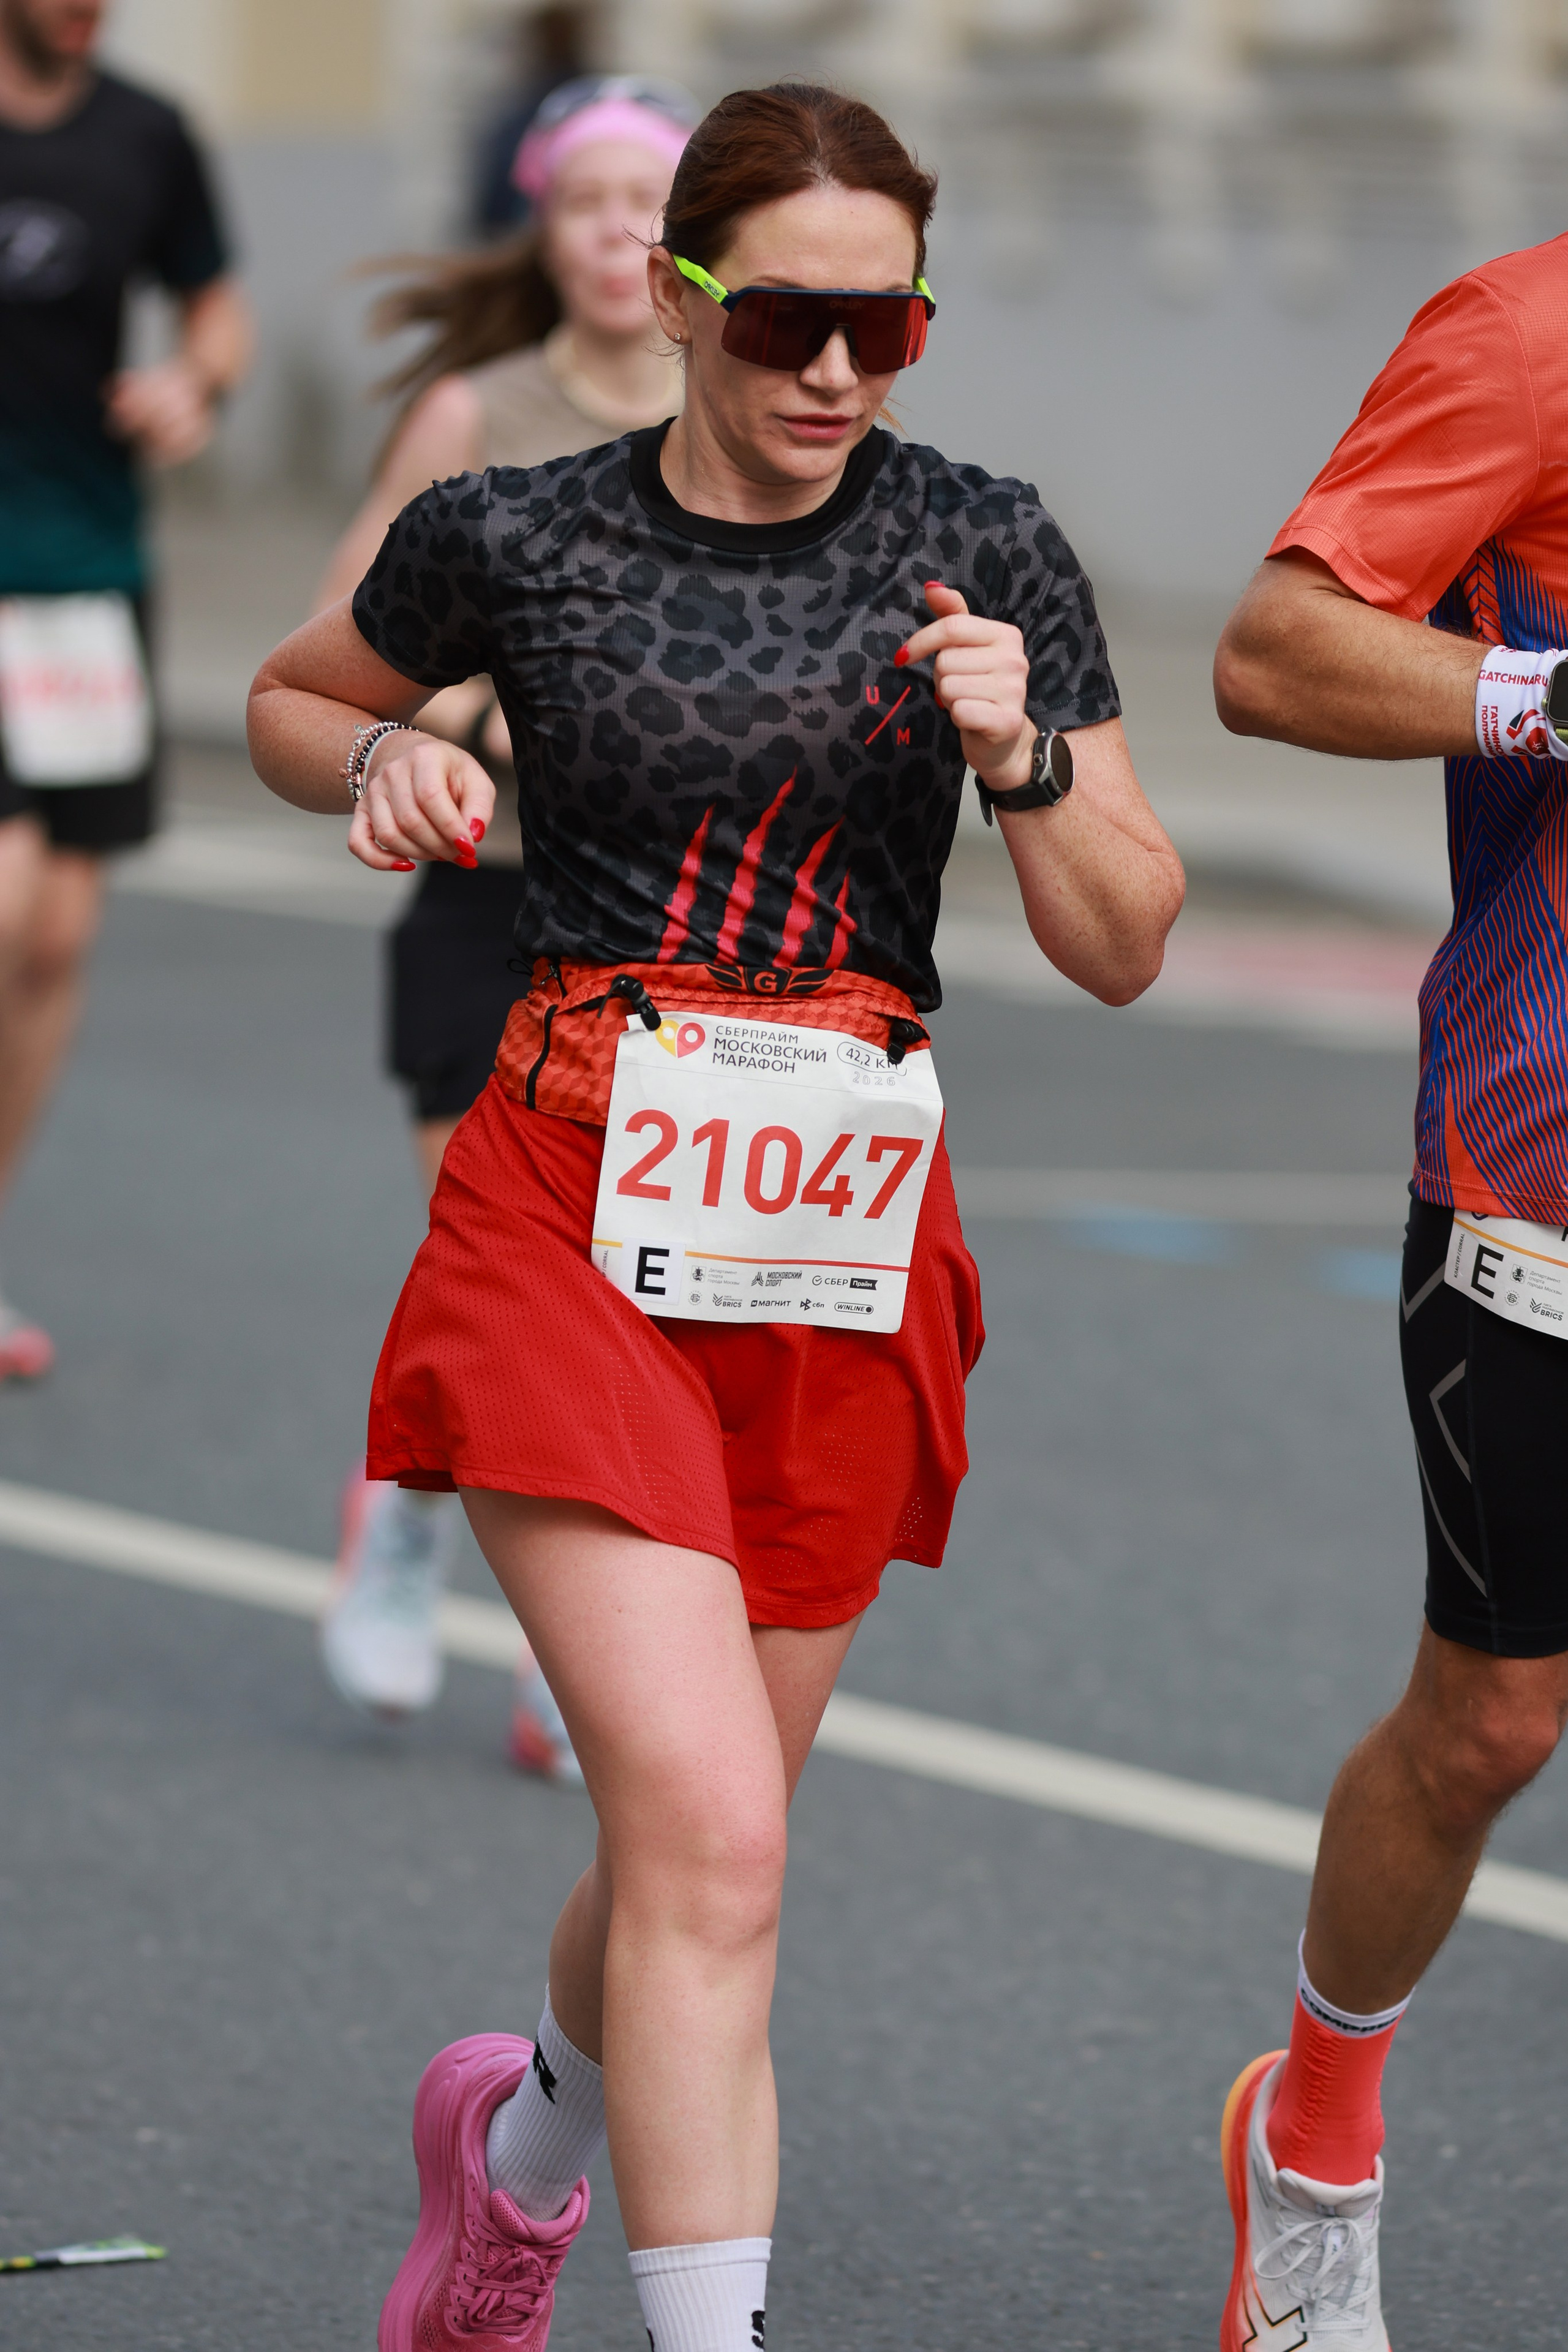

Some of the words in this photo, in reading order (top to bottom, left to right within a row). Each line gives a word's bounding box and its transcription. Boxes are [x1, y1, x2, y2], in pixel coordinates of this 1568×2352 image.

[754, 971, 777, 993] G
[715, 1025, 799, 1044] СБЕРПРАЙМ
[714, 1038, 827, 1063] МОСКОВСКИЙ
[846, 1047, 871, 1067] 42,2
[712, 1052, 796, 1073] МАРАФОН
[852, 1071, 896, 1087] 2026
[616, 1108, 924, 1219] 21047
[635, 1246, 670, 1295] E
[767, 1270, 803, 1280] МОСКОВСКИЙ
[1471, 1243, 1504, 1300] E
[1529, 1270, 1561, 1283] Департамент
[824, 1278, 848, 1286] СБЕР
[1544, 1286, 1563, 1295] Москвы
[837, 1303, 865, 1313] WINLINE
[1540, 1309, 1563, 1321] BRICS
